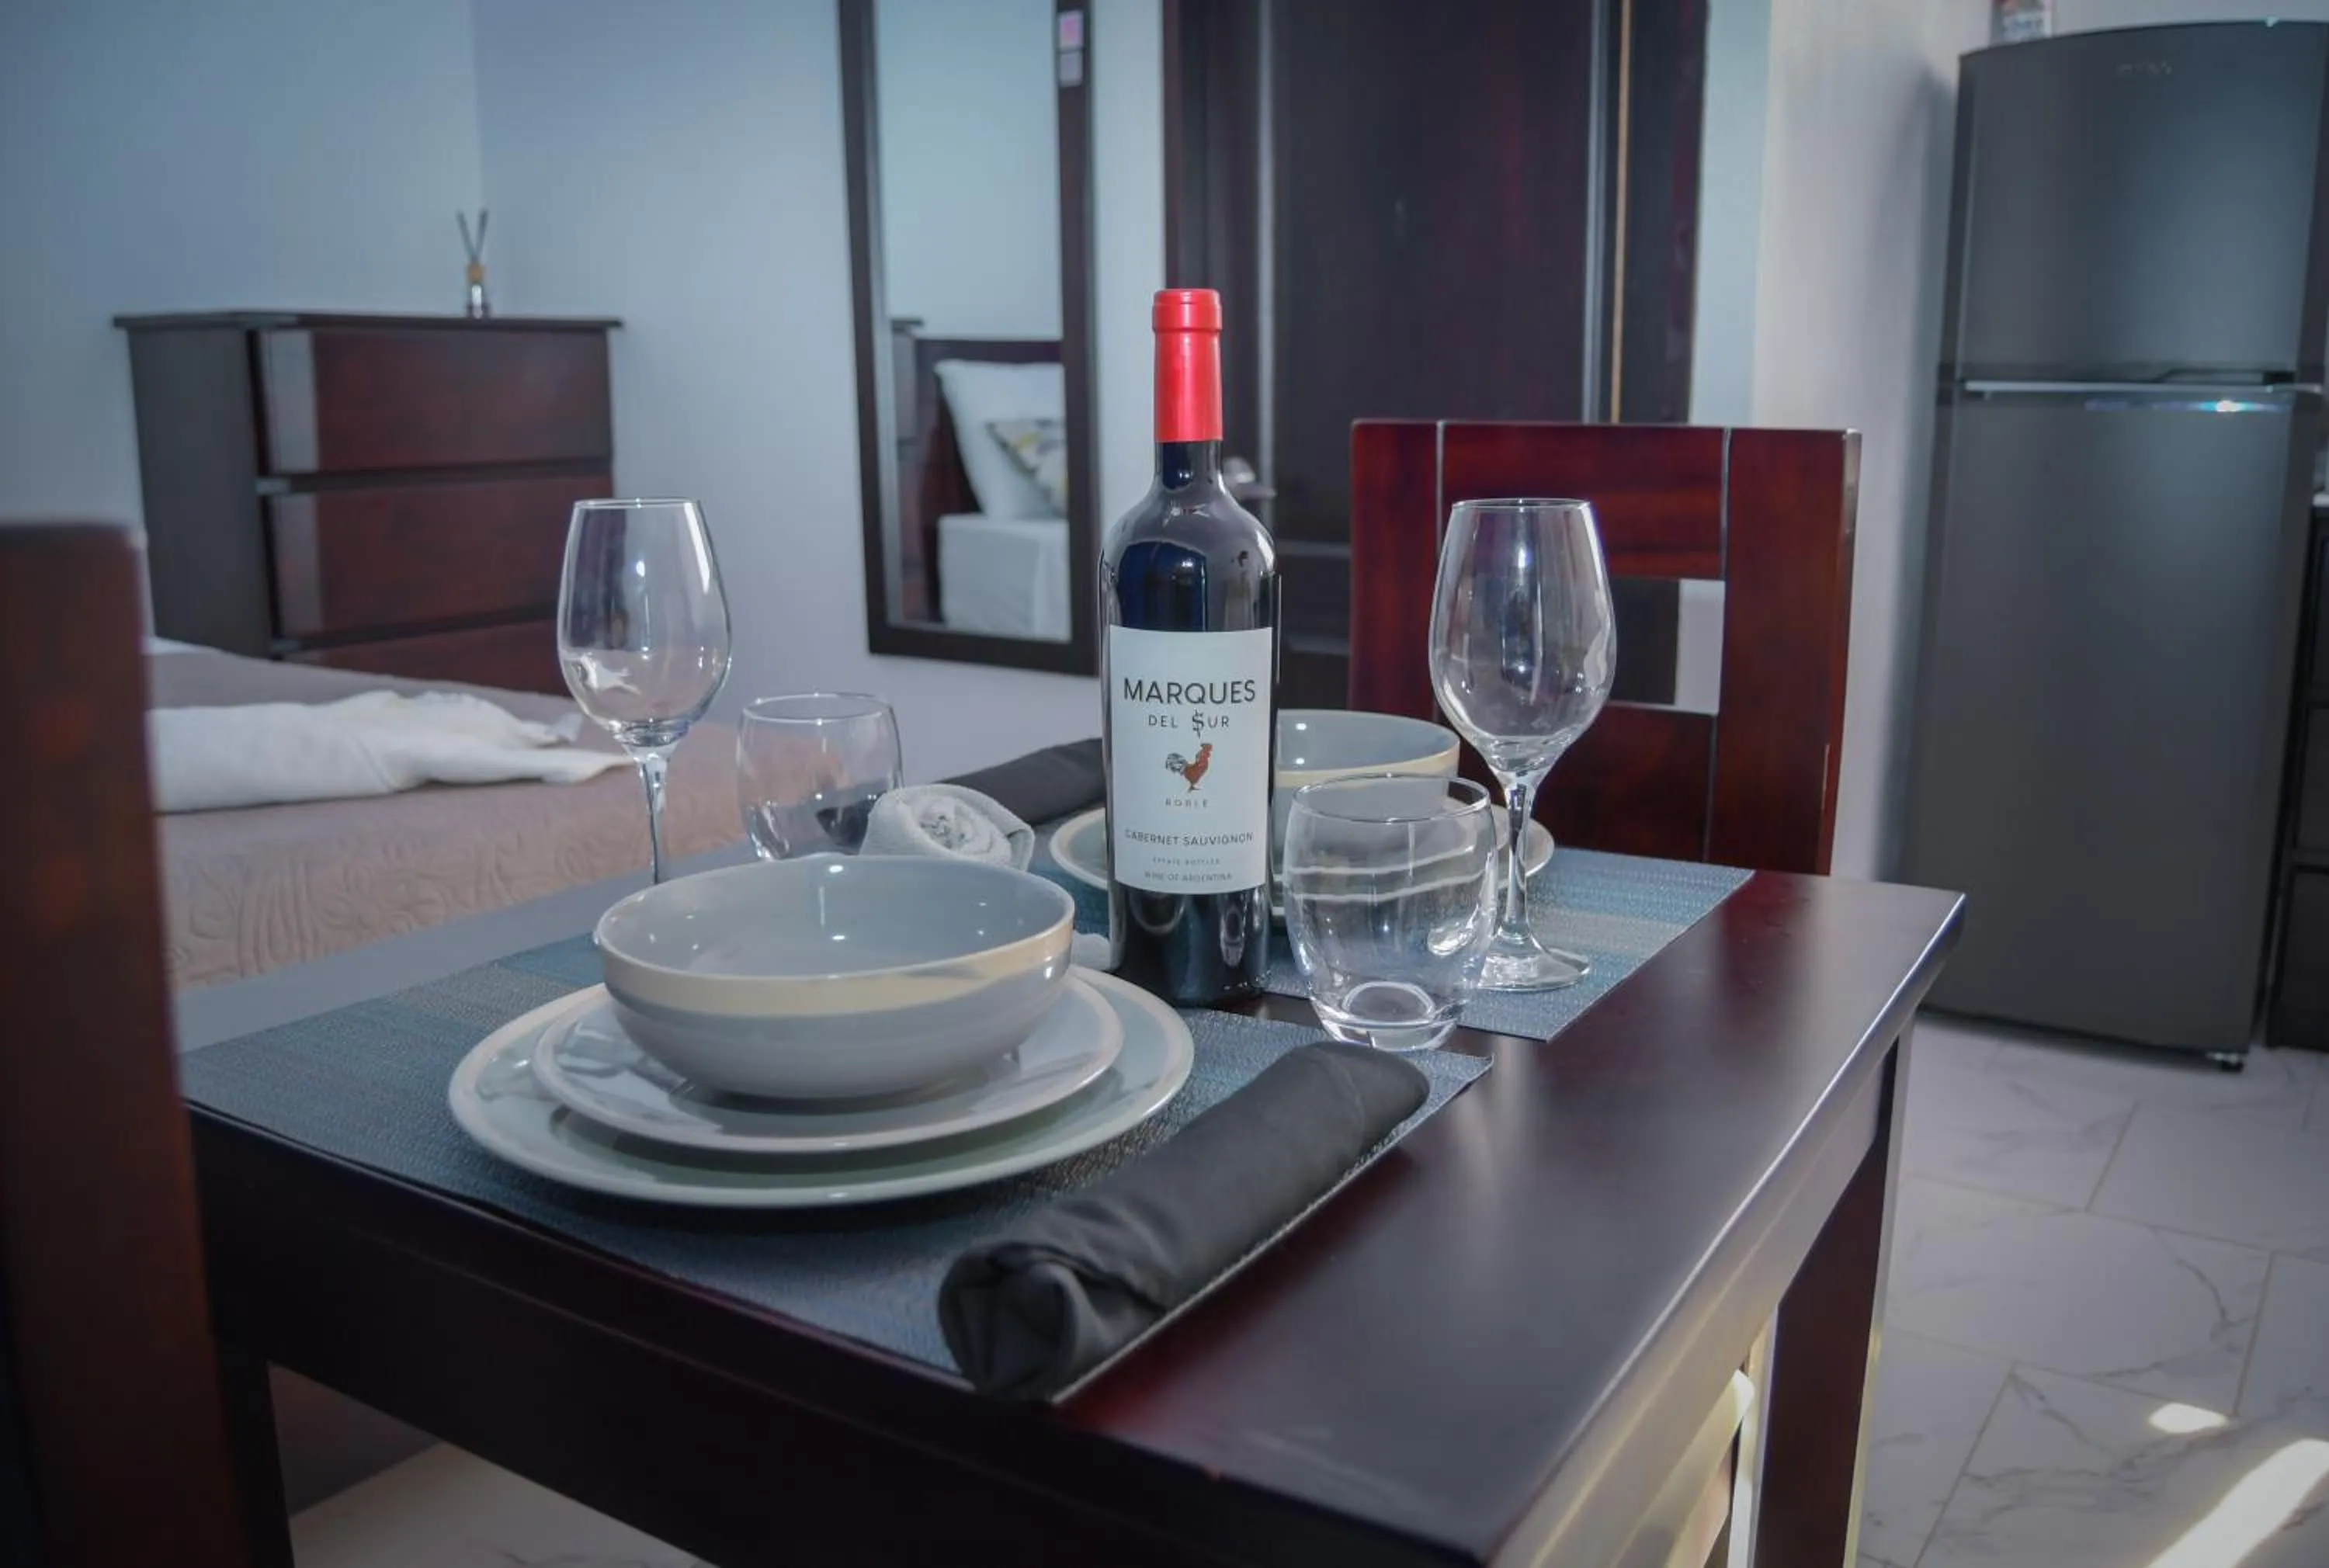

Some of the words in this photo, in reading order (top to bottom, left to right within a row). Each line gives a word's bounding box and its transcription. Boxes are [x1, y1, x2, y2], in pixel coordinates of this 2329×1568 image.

[1123, 676, 1256, 705] MARQUES
[1148, 713, 1178, 729] DEL
[1124, 828, 1178, 846] CABERNET
[1182, 831, 1255, 847] SAUVIGNON
